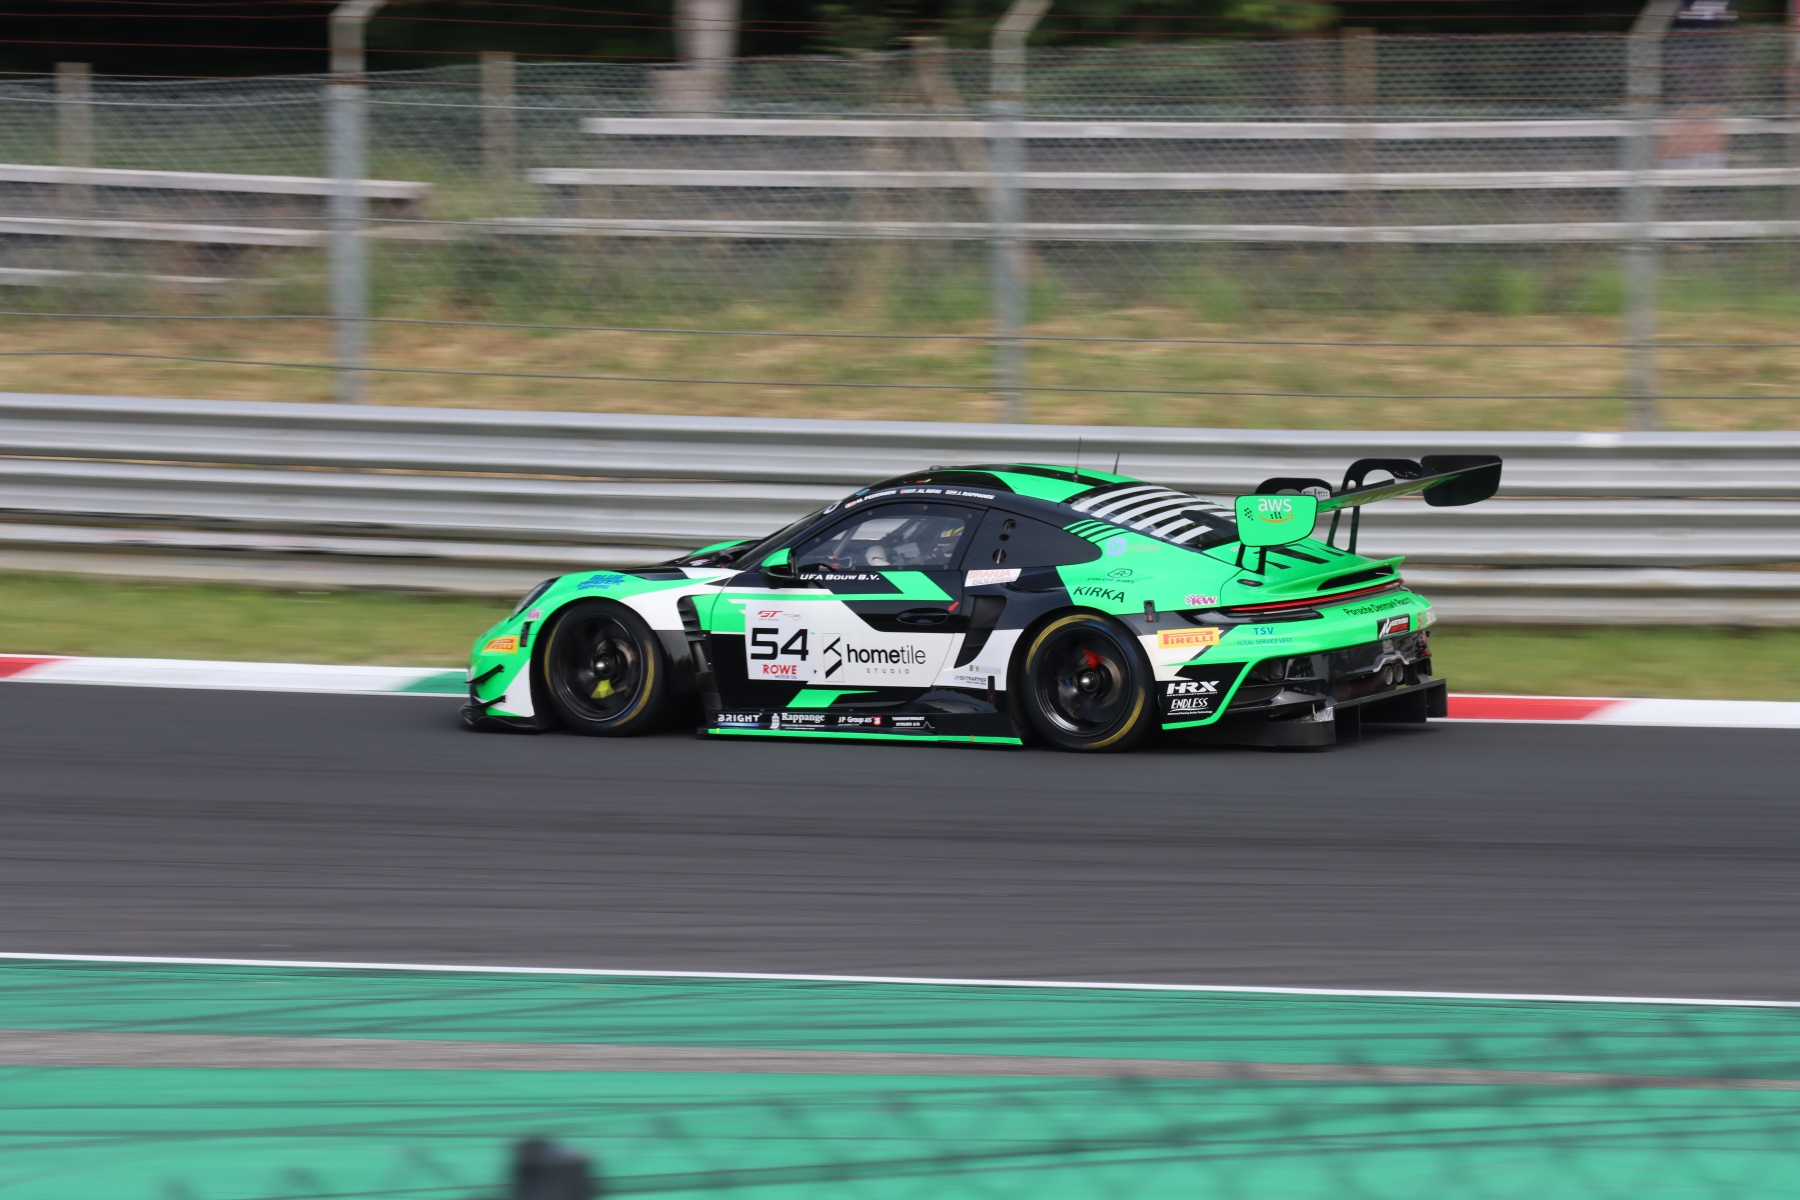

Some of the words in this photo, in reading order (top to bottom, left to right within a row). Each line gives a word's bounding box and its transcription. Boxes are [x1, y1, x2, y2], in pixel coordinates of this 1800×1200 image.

[1258, 498, 1292, 512] aws
[1073, 586, 1126, 603] KIRKA
[1190, 596, 1216, 606] KW
[1342, 603, 1374, 616] Porsche
[1370, 598, 1398, 612] Denmark
[1253, 627, 1274, 635] TSV
[1163, 631, 1214, 645] PIRELLI
[751, 628, 809, 661] 54
[846, 644, 926, 664] hometile
[762, 664, 798, 675] ROWE
[1166, 681, 1220, 694] HRX
[1171, 697, 1209, 709] ENDLESS
[717, 714, 760, 722] BRIGHT
[781, 713, 826, 723] Rappange
[847, 716, 865, 724] Group
